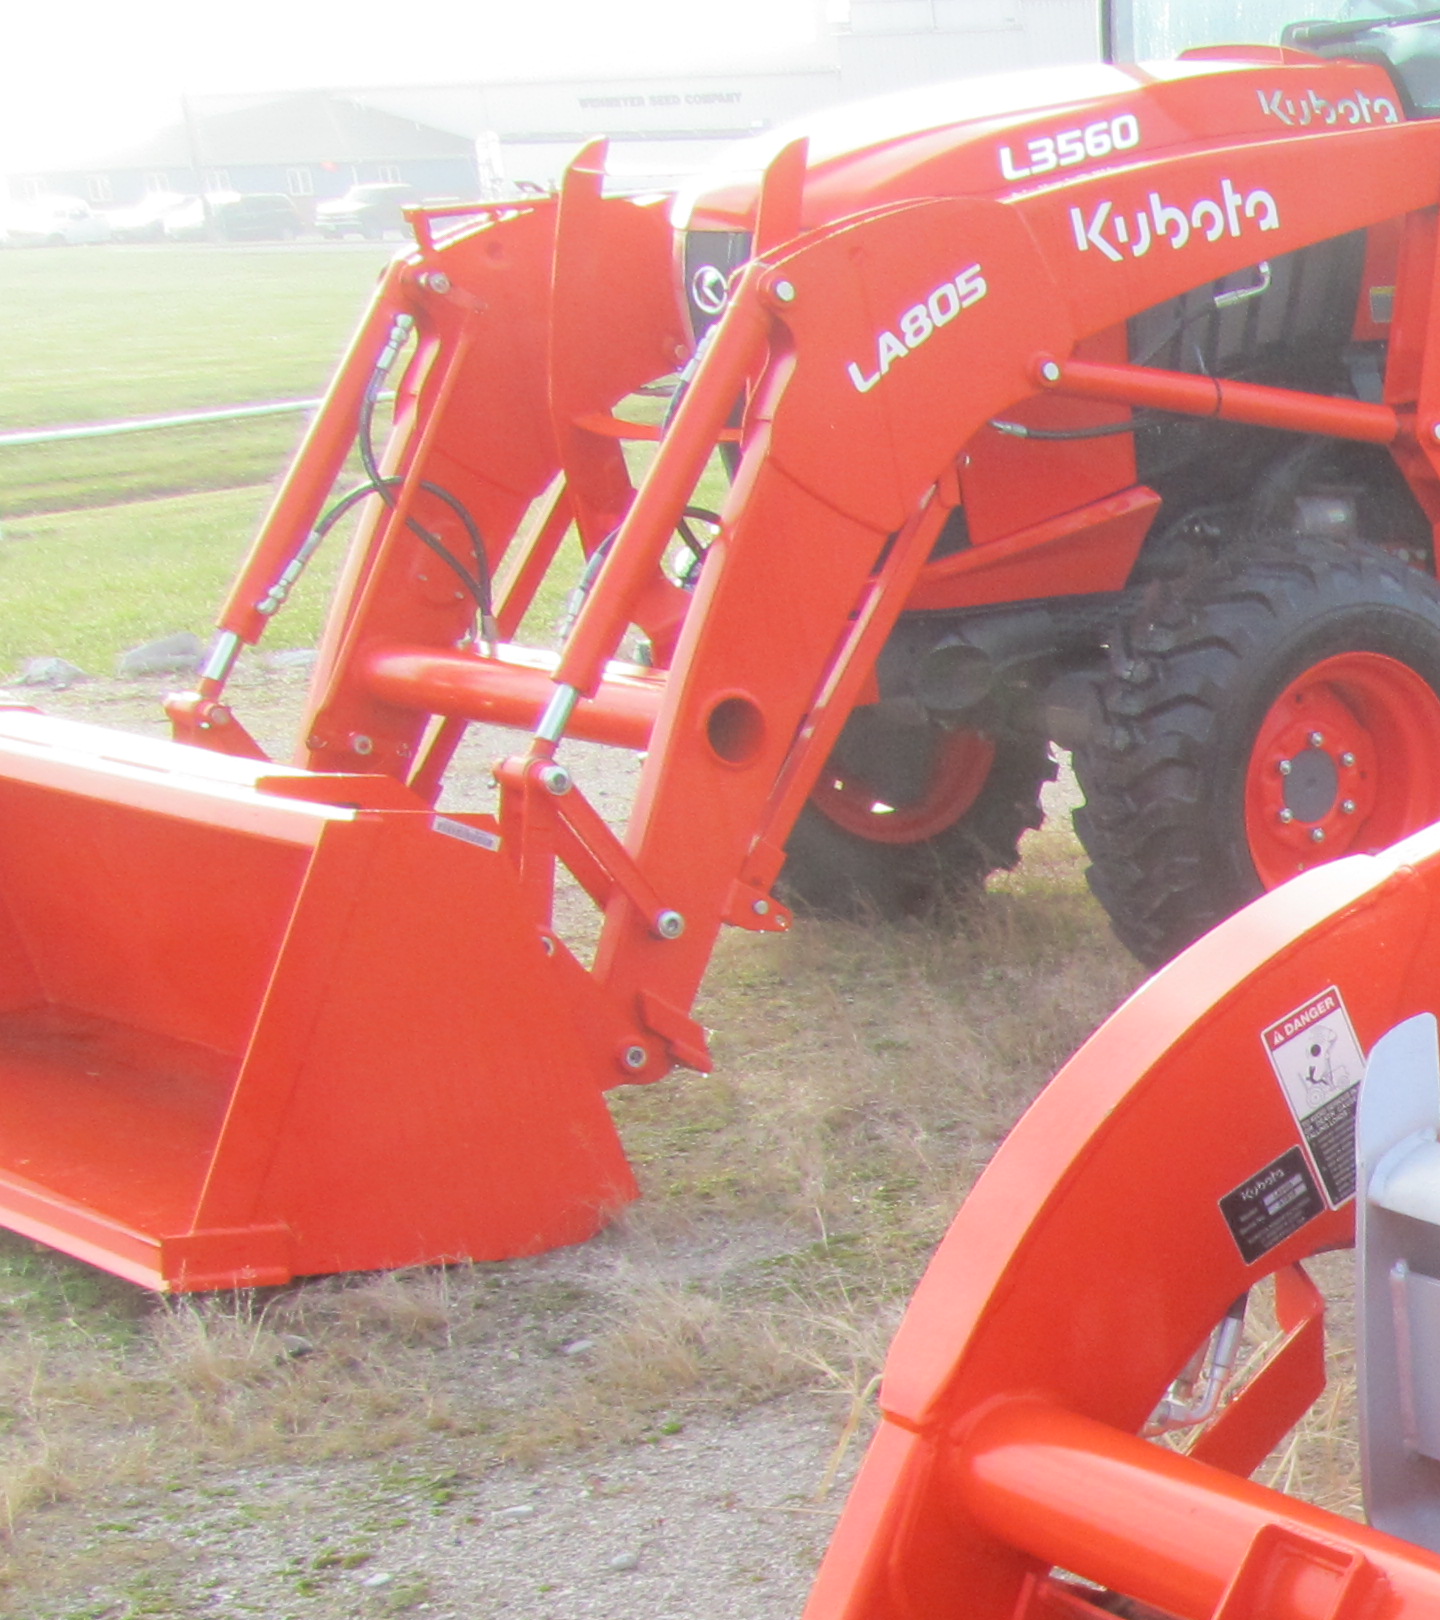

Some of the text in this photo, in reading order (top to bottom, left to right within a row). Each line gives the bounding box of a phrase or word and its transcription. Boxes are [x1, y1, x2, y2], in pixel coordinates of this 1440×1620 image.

[649, 94, 681, 106] SEED
[684, 91, 742, 105] COMPANY
[1257, 87, 1399, 127] Kubota
[999, 114, 1140, 182] L3560
[1071, 178, 1280, 263] Kubota
[846, 263, 990, 394] LA805
[1284, 995, 1336, 1036] DANGER
[1241, 1168, 1285, 1201] Kubota
